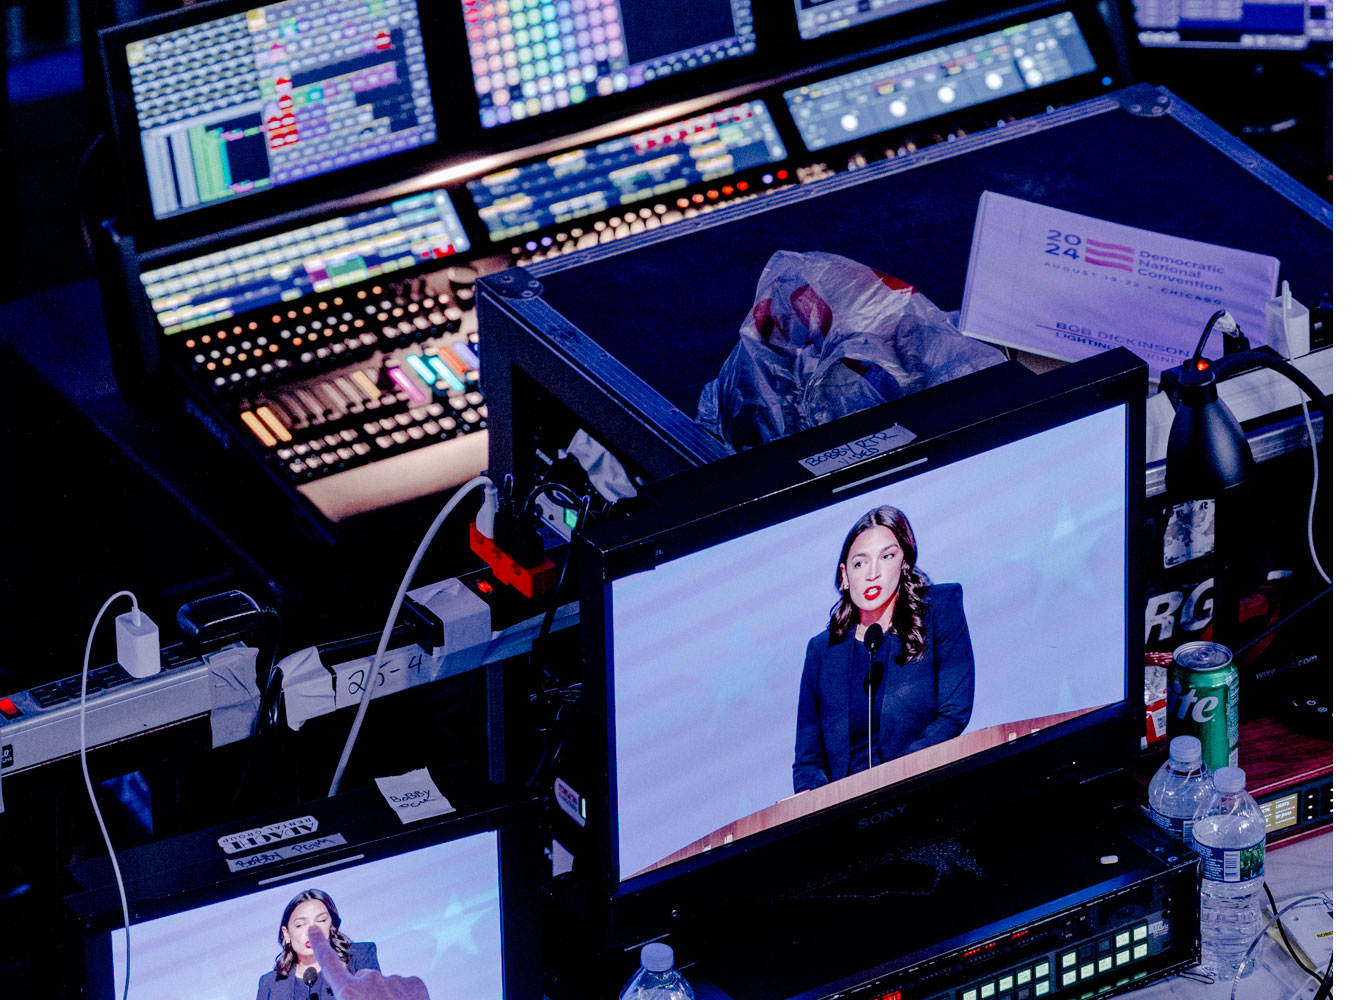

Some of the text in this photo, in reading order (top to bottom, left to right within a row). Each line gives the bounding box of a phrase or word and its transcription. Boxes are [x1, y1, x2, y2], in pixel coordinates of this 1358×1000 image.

[1047, 230, 1081, 246] 20
[1045, 243, 1080, 260] 24
[1140, 250, 1225, 275] Democratic
[1138, 269, 1223, 292] Convention
[1139, 260, 1200, 278] National
[1044, 261, 1097, 278] AUGUST
[1161, 288, 1222, 305] CHICAGO
[1056, 322, 1190, 358] BOB DICKINSON
[222, 817, 311, 844] RENTAL GROUP
